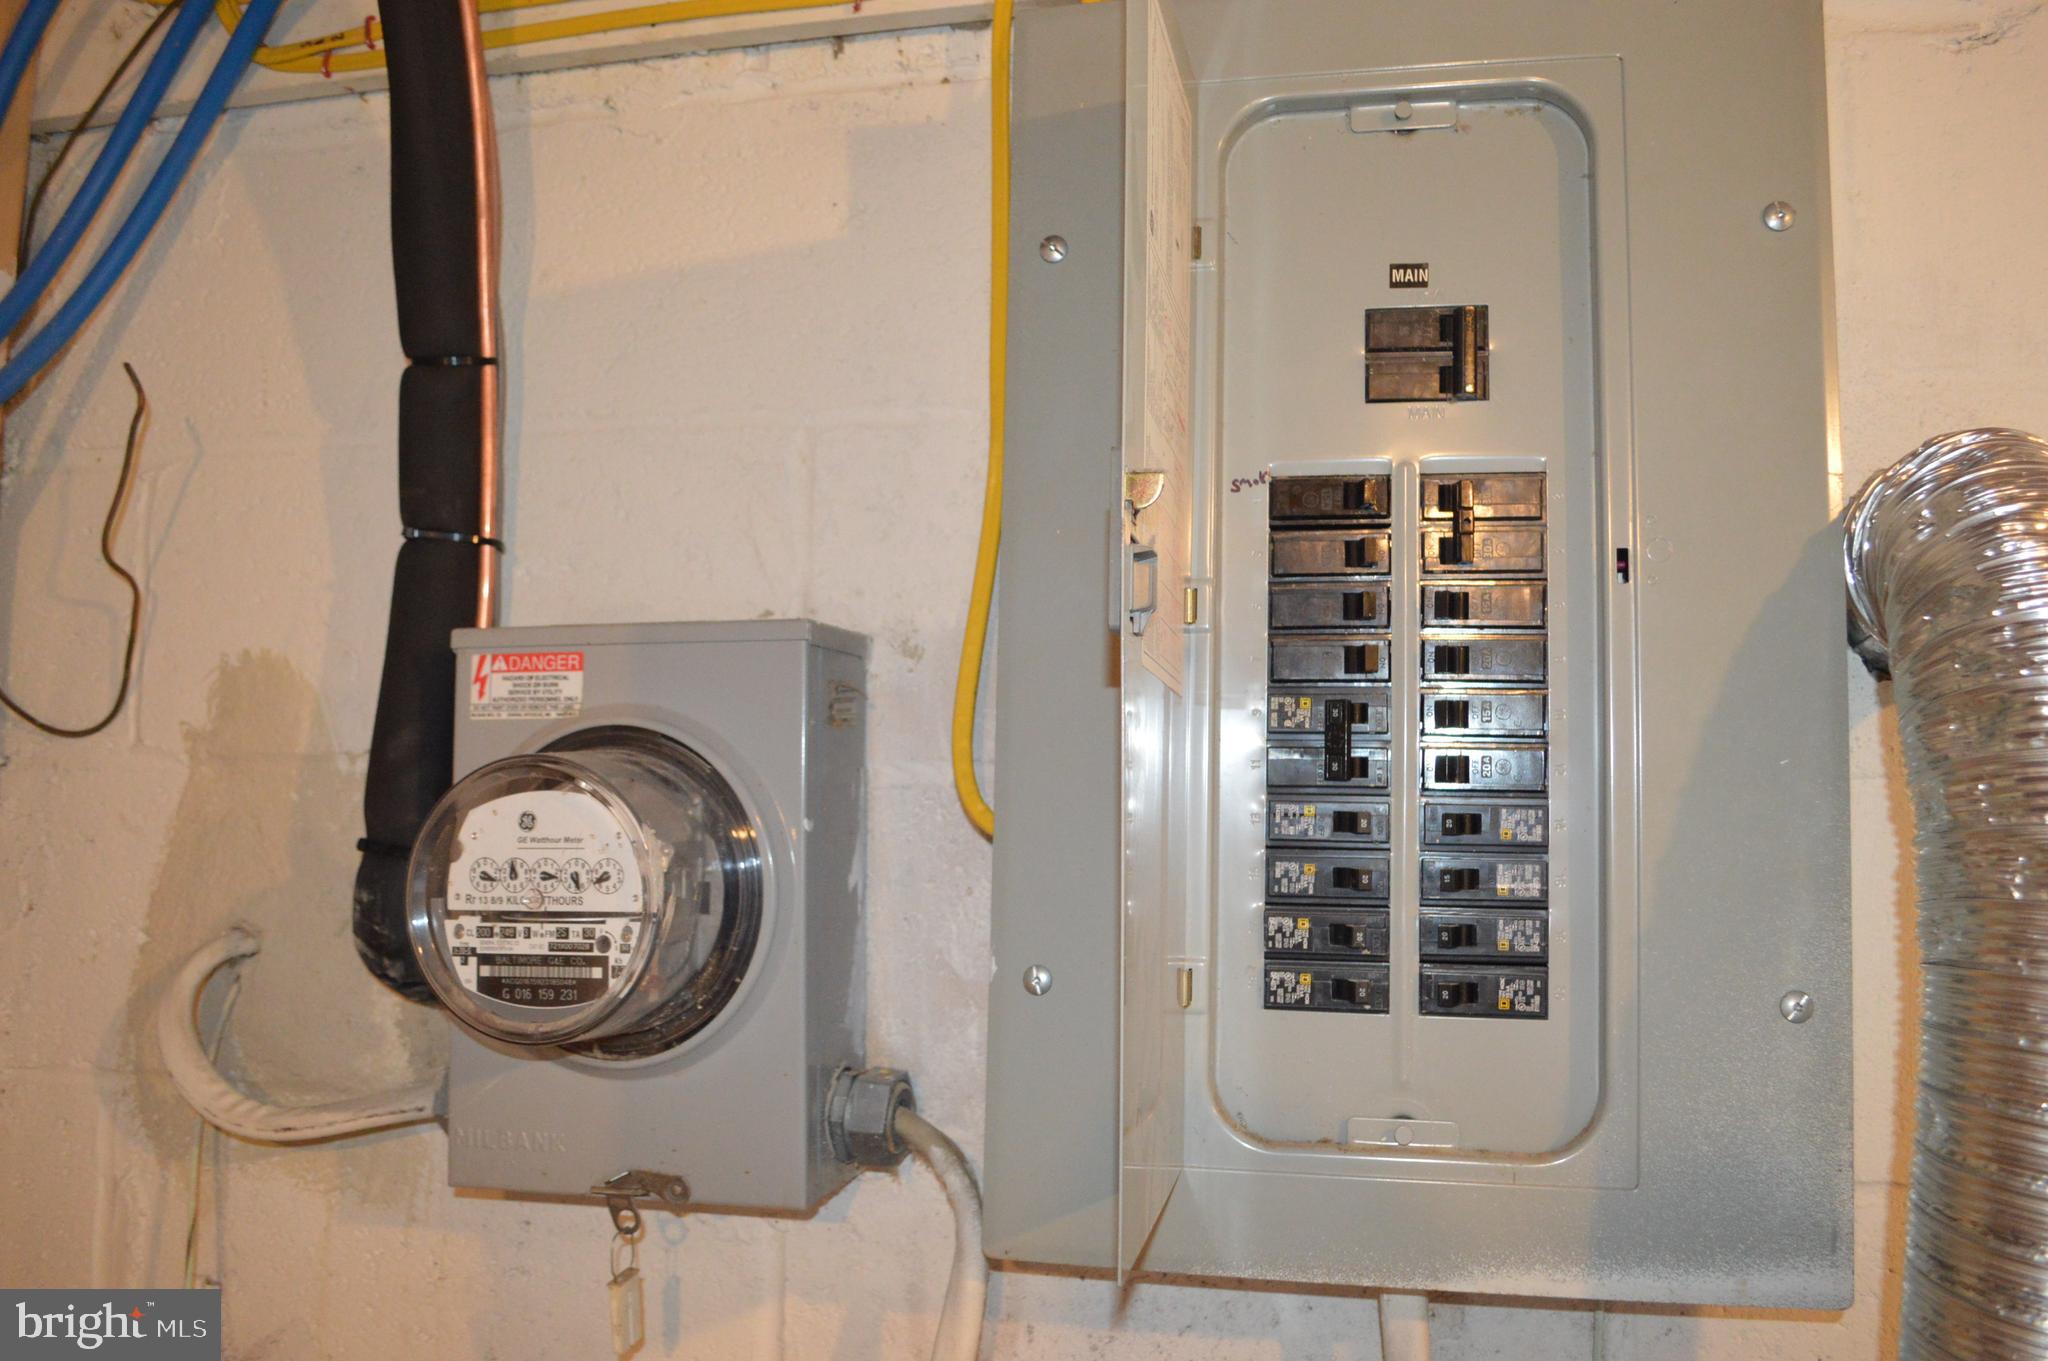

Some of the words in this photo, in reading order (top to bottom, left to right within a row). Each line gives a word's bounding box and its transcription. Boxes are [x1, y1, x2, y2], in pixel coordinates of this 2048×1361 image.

[1391, 268, 1428, 283] MAIN
[509, 655, 579, 670] DANGER
[1481, 702, 1492, 723] 15A
[1481, 757, 1492, 778] 20A
[1361, 819, 1367, 829] 20
[1362, 874, 1368, 884] 20
[1444, 874, 1450, 884] 15
[477, 927, 491, 938] 200
[585, 928, 595, 939] 30
[1357, 932, 1363, 942] 20
[1442, 931, 1448, 941] 20
[502, 988, 510, 999] G
[515, 989, 532, 1000] 016
[538, 989, 554, 1000] 159
[560, 989, 578, 1001] 231
[1442, 990, 1449, 1000] 20
